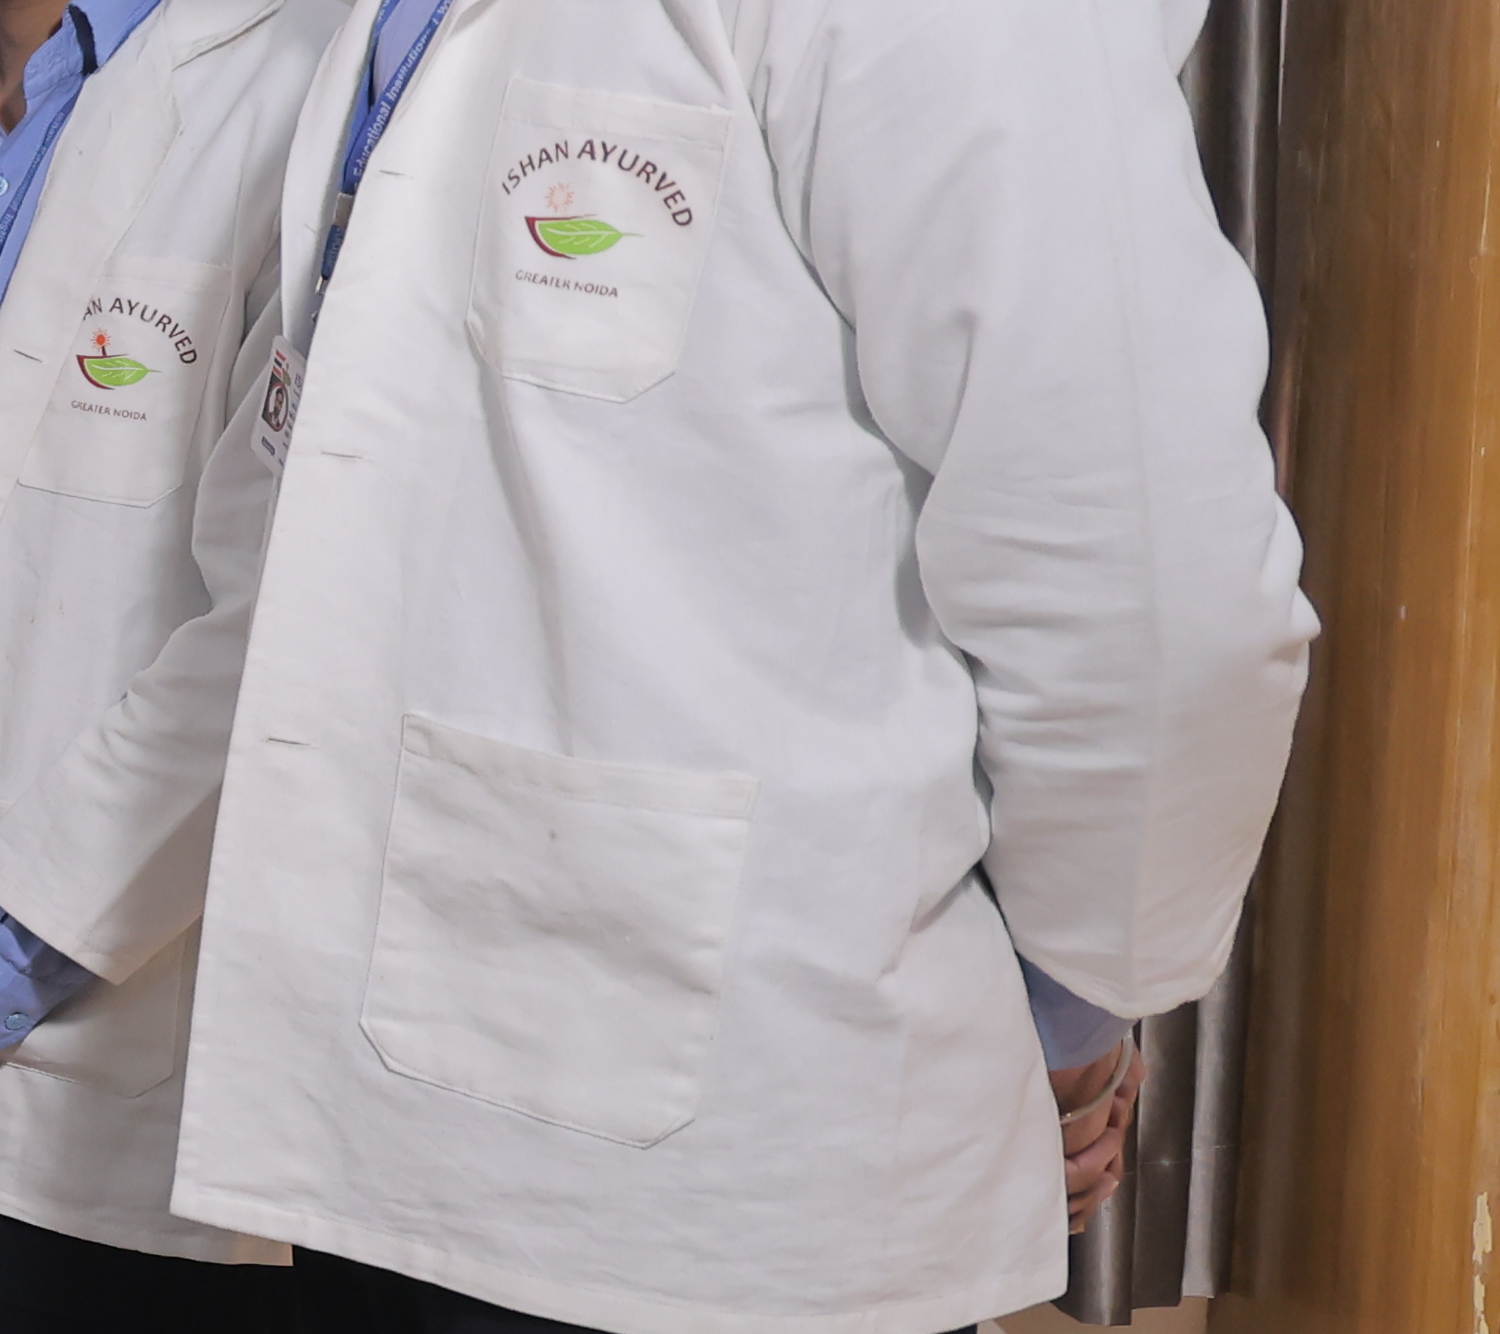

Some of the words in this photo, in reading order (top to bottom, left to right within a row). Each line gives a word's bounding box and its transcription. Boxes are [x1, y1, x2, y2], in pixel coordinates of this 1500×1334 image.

[501, 139, 569, 196] ISHAN
[576, 138, 694, 229] AYURVED
[573, 281, 619, 299] NOIDA
[108, 297, 198, 365] AYURVED
[113, 408, 147, 421] NOIDA
